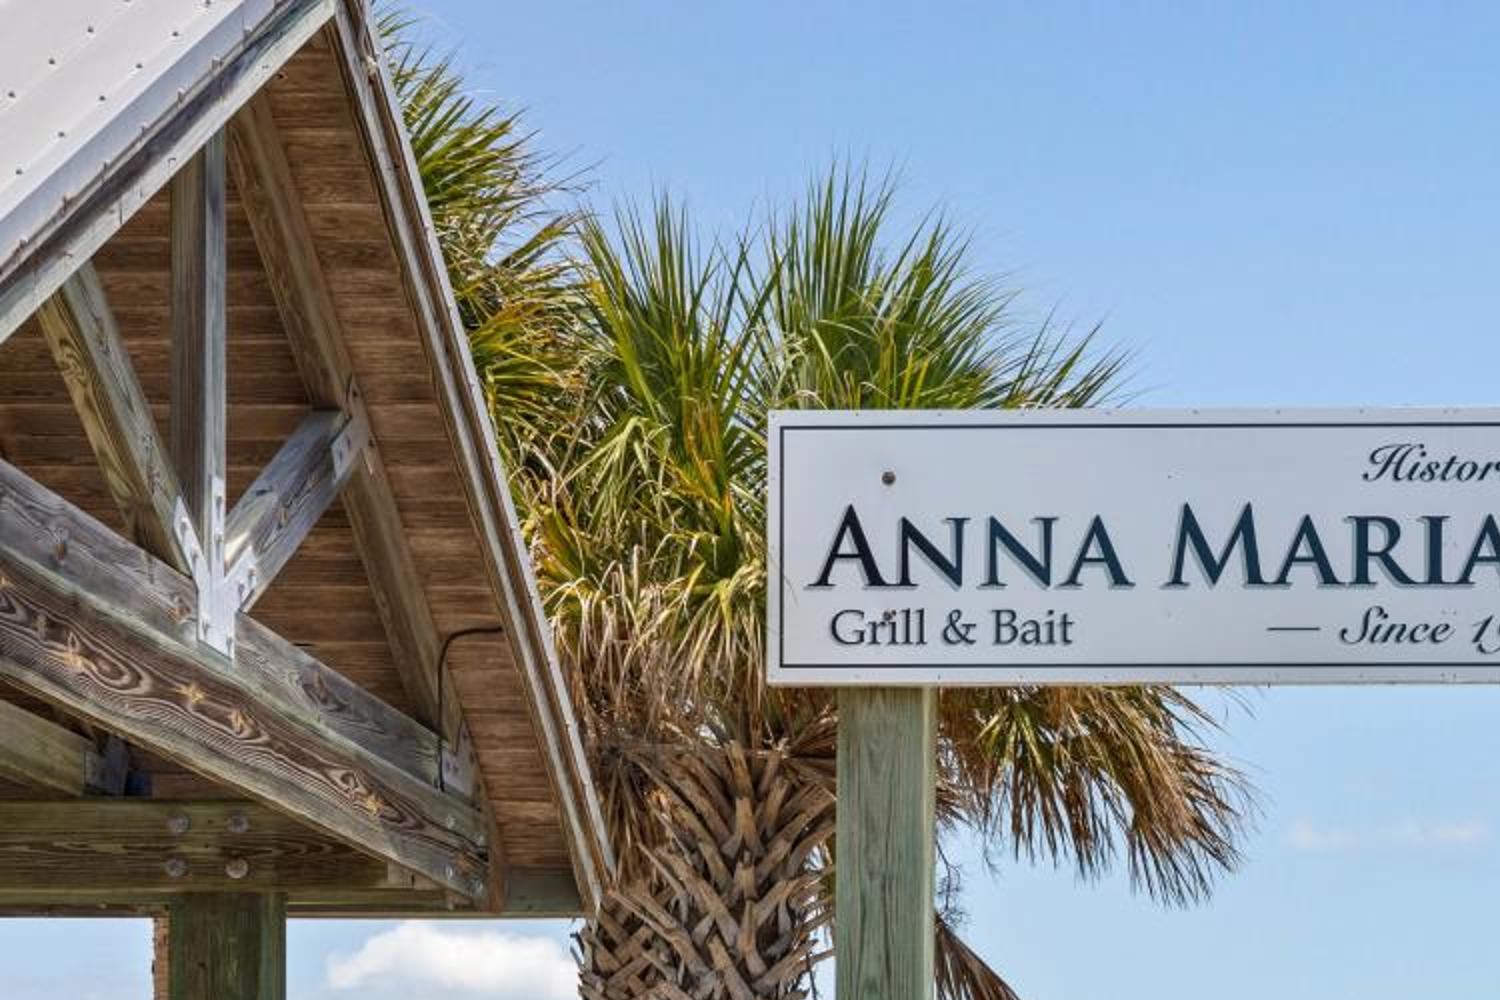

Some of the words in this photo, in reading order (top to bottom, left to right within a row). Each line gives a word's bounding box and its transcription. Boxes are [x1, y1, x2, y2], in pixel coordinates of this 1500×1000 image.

[804, 503, 1136, 590] ANNA
[830, 608, 927, 645] Grill
[942, 608, 977, 645] &
[992, 608, 1075, 645] Bait
[1338, 605, 1456, 645] Since
